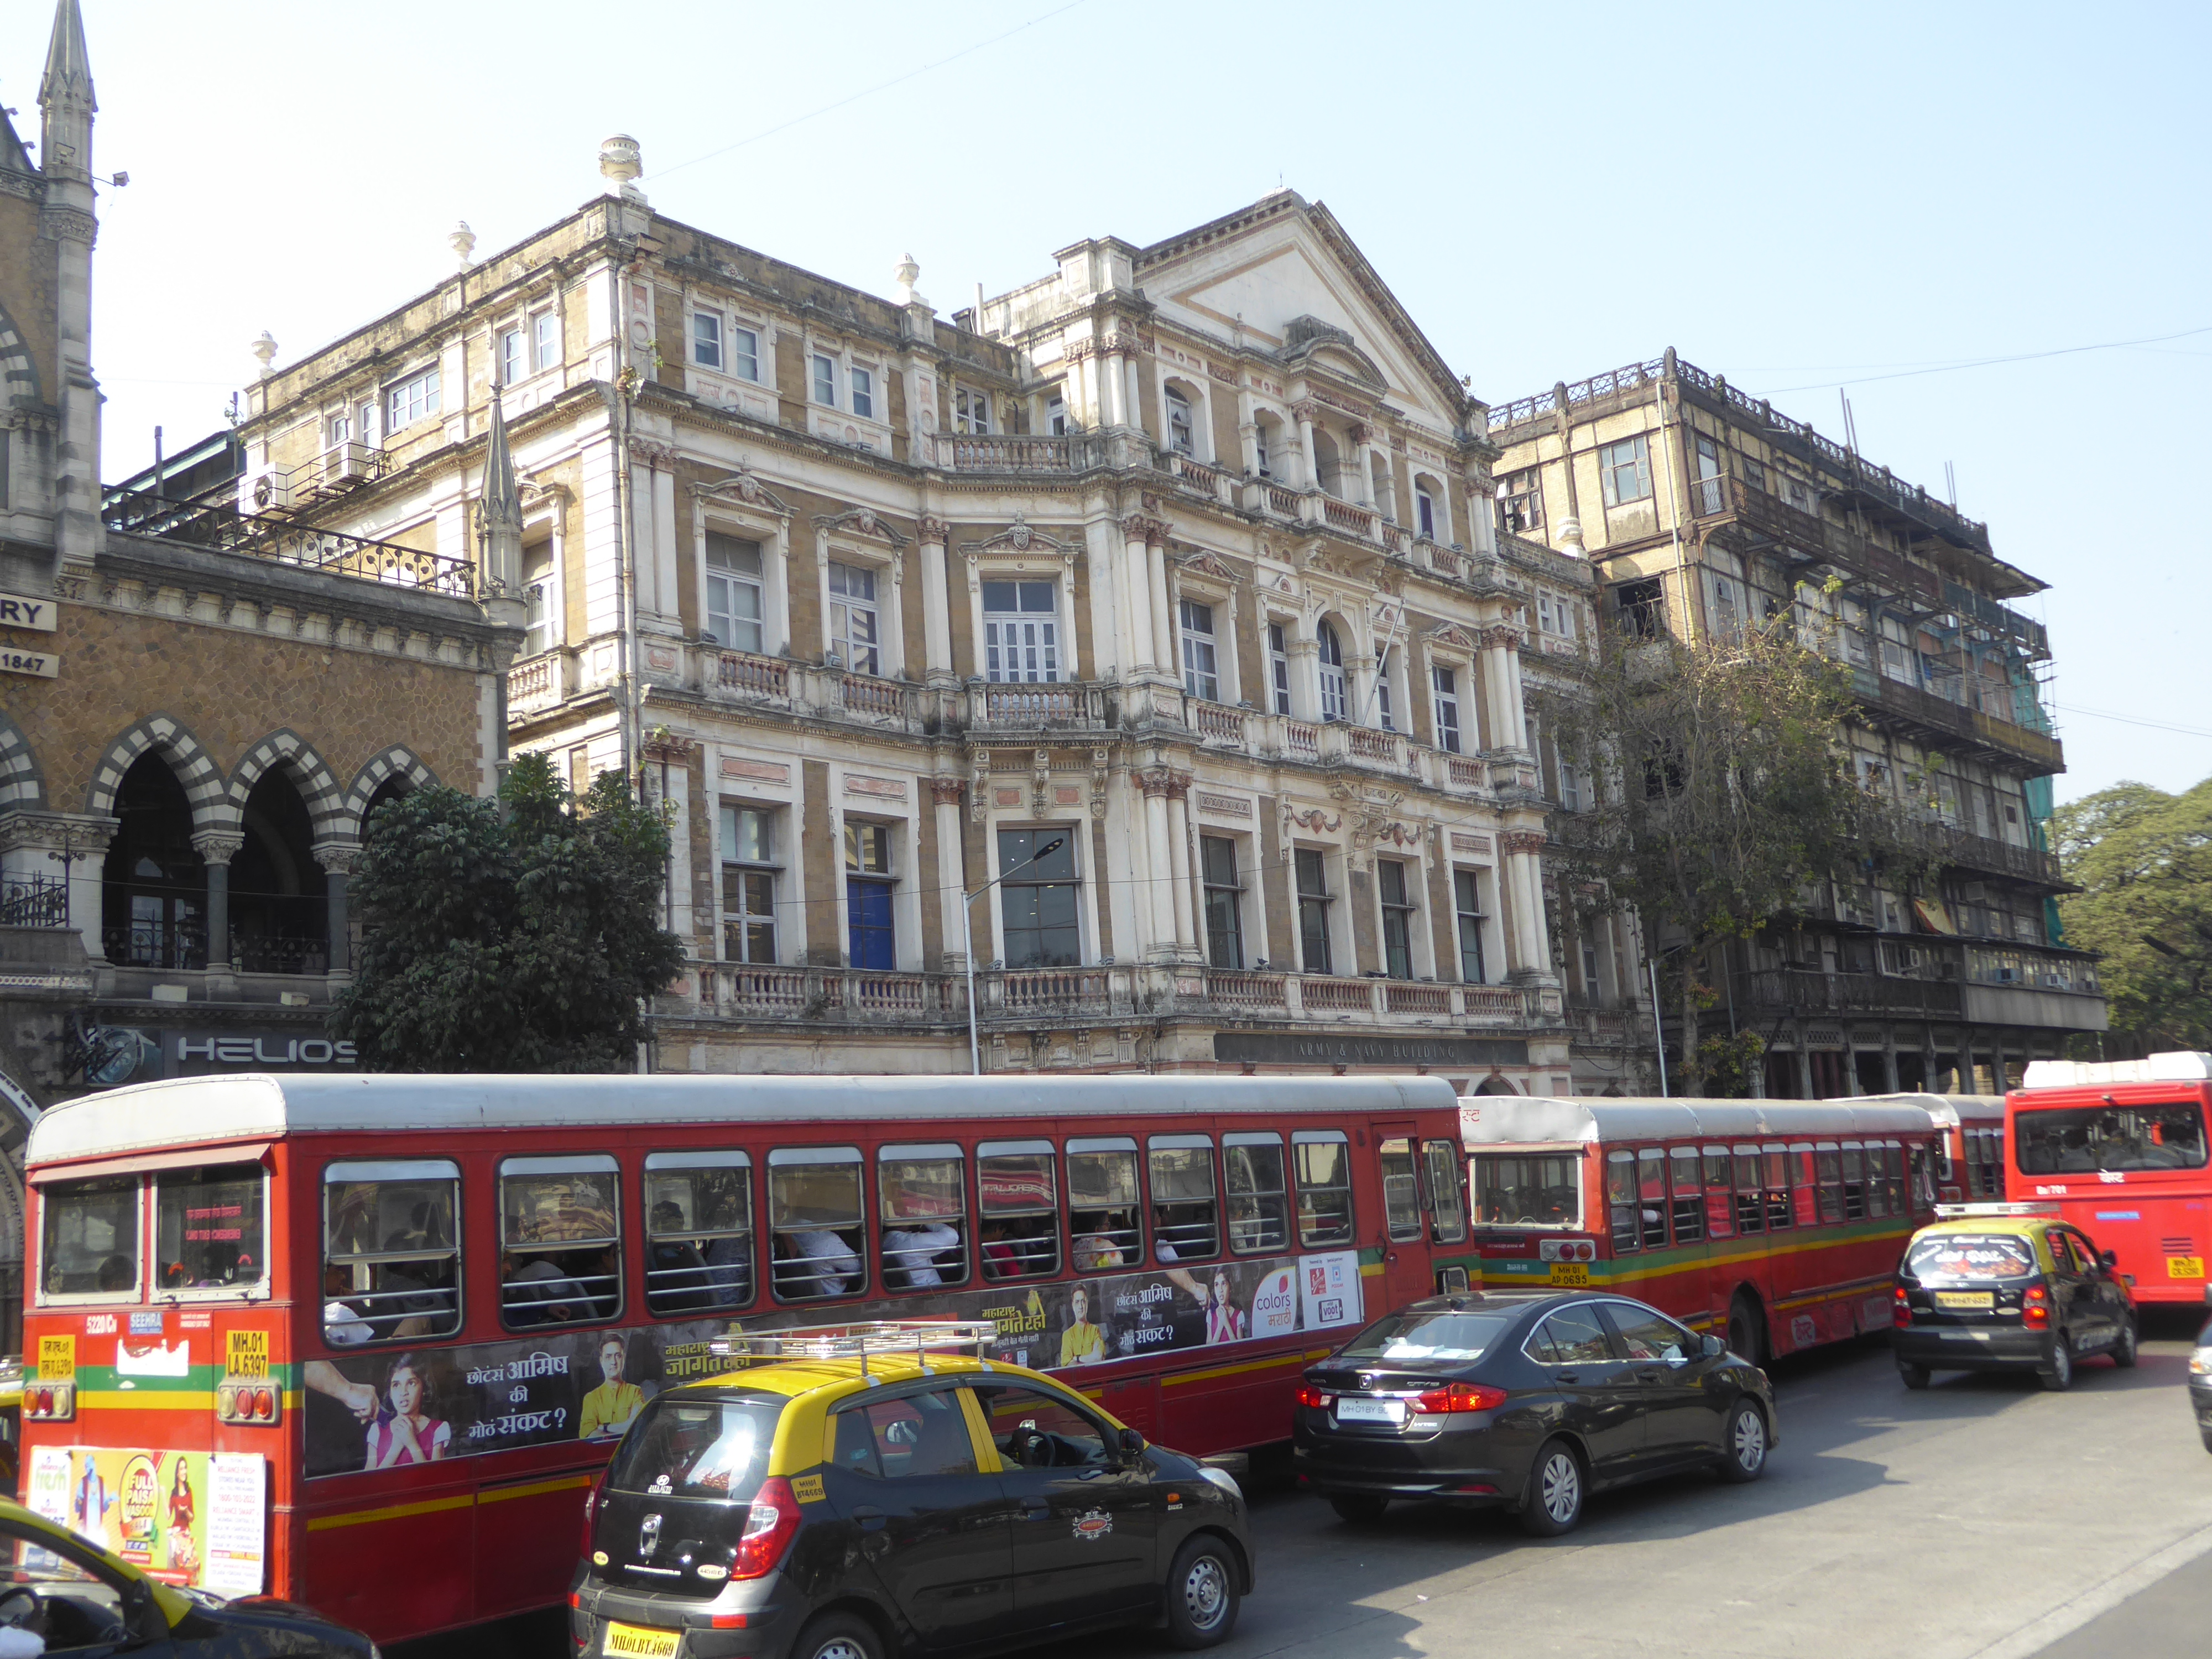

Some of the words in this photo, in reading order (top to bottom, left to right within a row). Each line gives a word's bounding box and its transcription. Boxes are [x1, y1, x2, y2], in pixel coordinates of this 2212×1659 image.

[2, 653, 45, 672] 1847
[178, 1037, 359, 1063] HELIOS
[1300, 1042, 1332, 1057] ARMY
[1339, 1044, 1346, 1057] &
[1354, 1044, 1384, 1057] NAVY
[1393, 1045, 1454, 1058] BUILDING
[1139, 1283, 1172, 1303] आमिष
[1256, 1293, 1290, 1311] colors
[1140, 1308, 1151, 1321] की
[1267, 1307, 1291, 1327] मराठी
[1323, 1304, 1338, 1316] voot
[131, 1312, 161, 1328] SEEHRA
[233, 1332, 262, 1353] MH.01
[228, 1354, 267, 1378] LA.6397
[507, 1352, 568, 1379] आमिष
[509, 1385, 529, 1403] की
[469, 1418, 495, 1438] मोठं
[130, 1475, 153, 1490] FULL
[127, 1489, 154, 1505] PAISA
